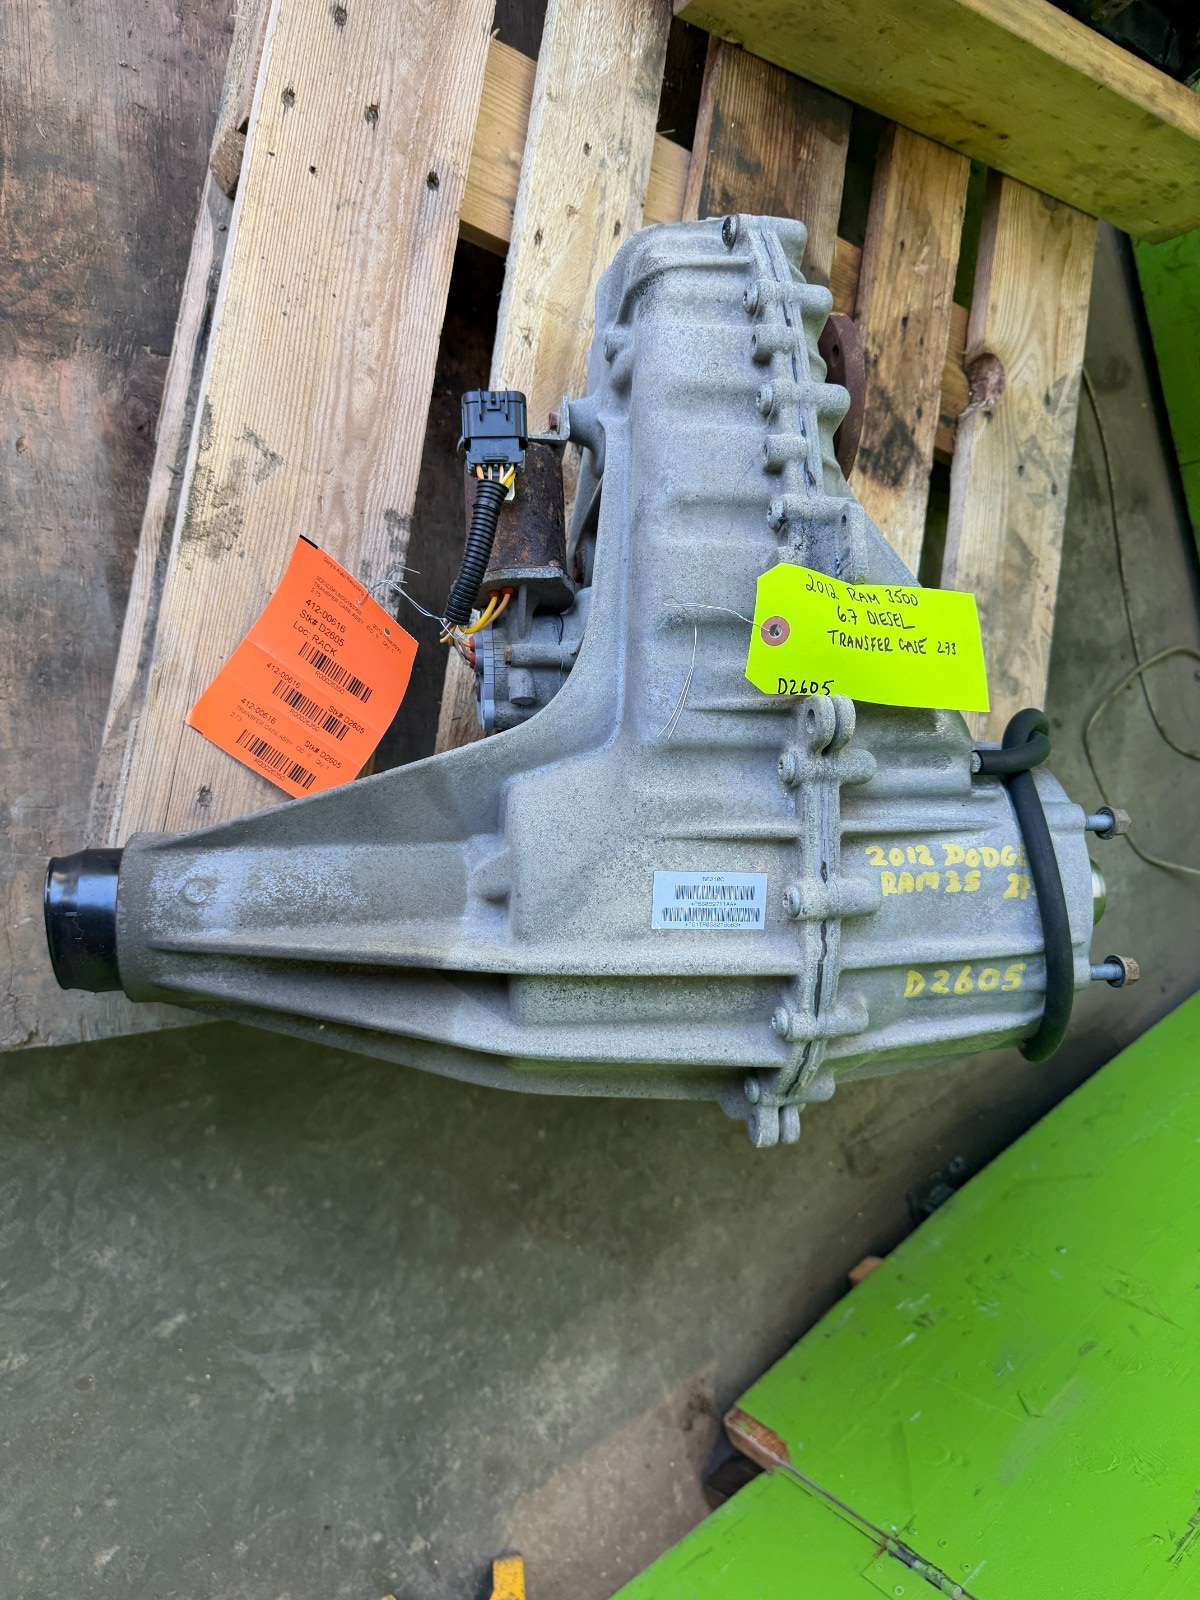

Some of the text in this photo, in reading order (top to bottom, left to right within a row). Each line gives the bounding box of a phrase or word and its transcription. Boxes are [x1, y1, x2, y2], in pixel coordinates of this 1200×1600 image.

[806, 574, 918, 606] 2012 RAM 3500
[299, 610, 344, 646] Stk# D2605
[305, 600, 346, 634] 412-00616
[837, 606, 916, 629] 6.7 DIESEL
[292, 621, 338, 656] Loc: RACK
[827, 630, 893, 652] TRANSFER
[898, 637, 928, 654] CASE
[266, 662, 366, 734] 412-00616 Stk# D2605
[778, 678, 834, 696] D2605
[236, 704, 265, 728] TRANSFER
[264, 724, 280, 738] CASE
[240, 698, 342, 769] 412-00616 Stk# D2605
[865, 845, 934, 866] 2012
[904, 963, 1027, 998] D2605
